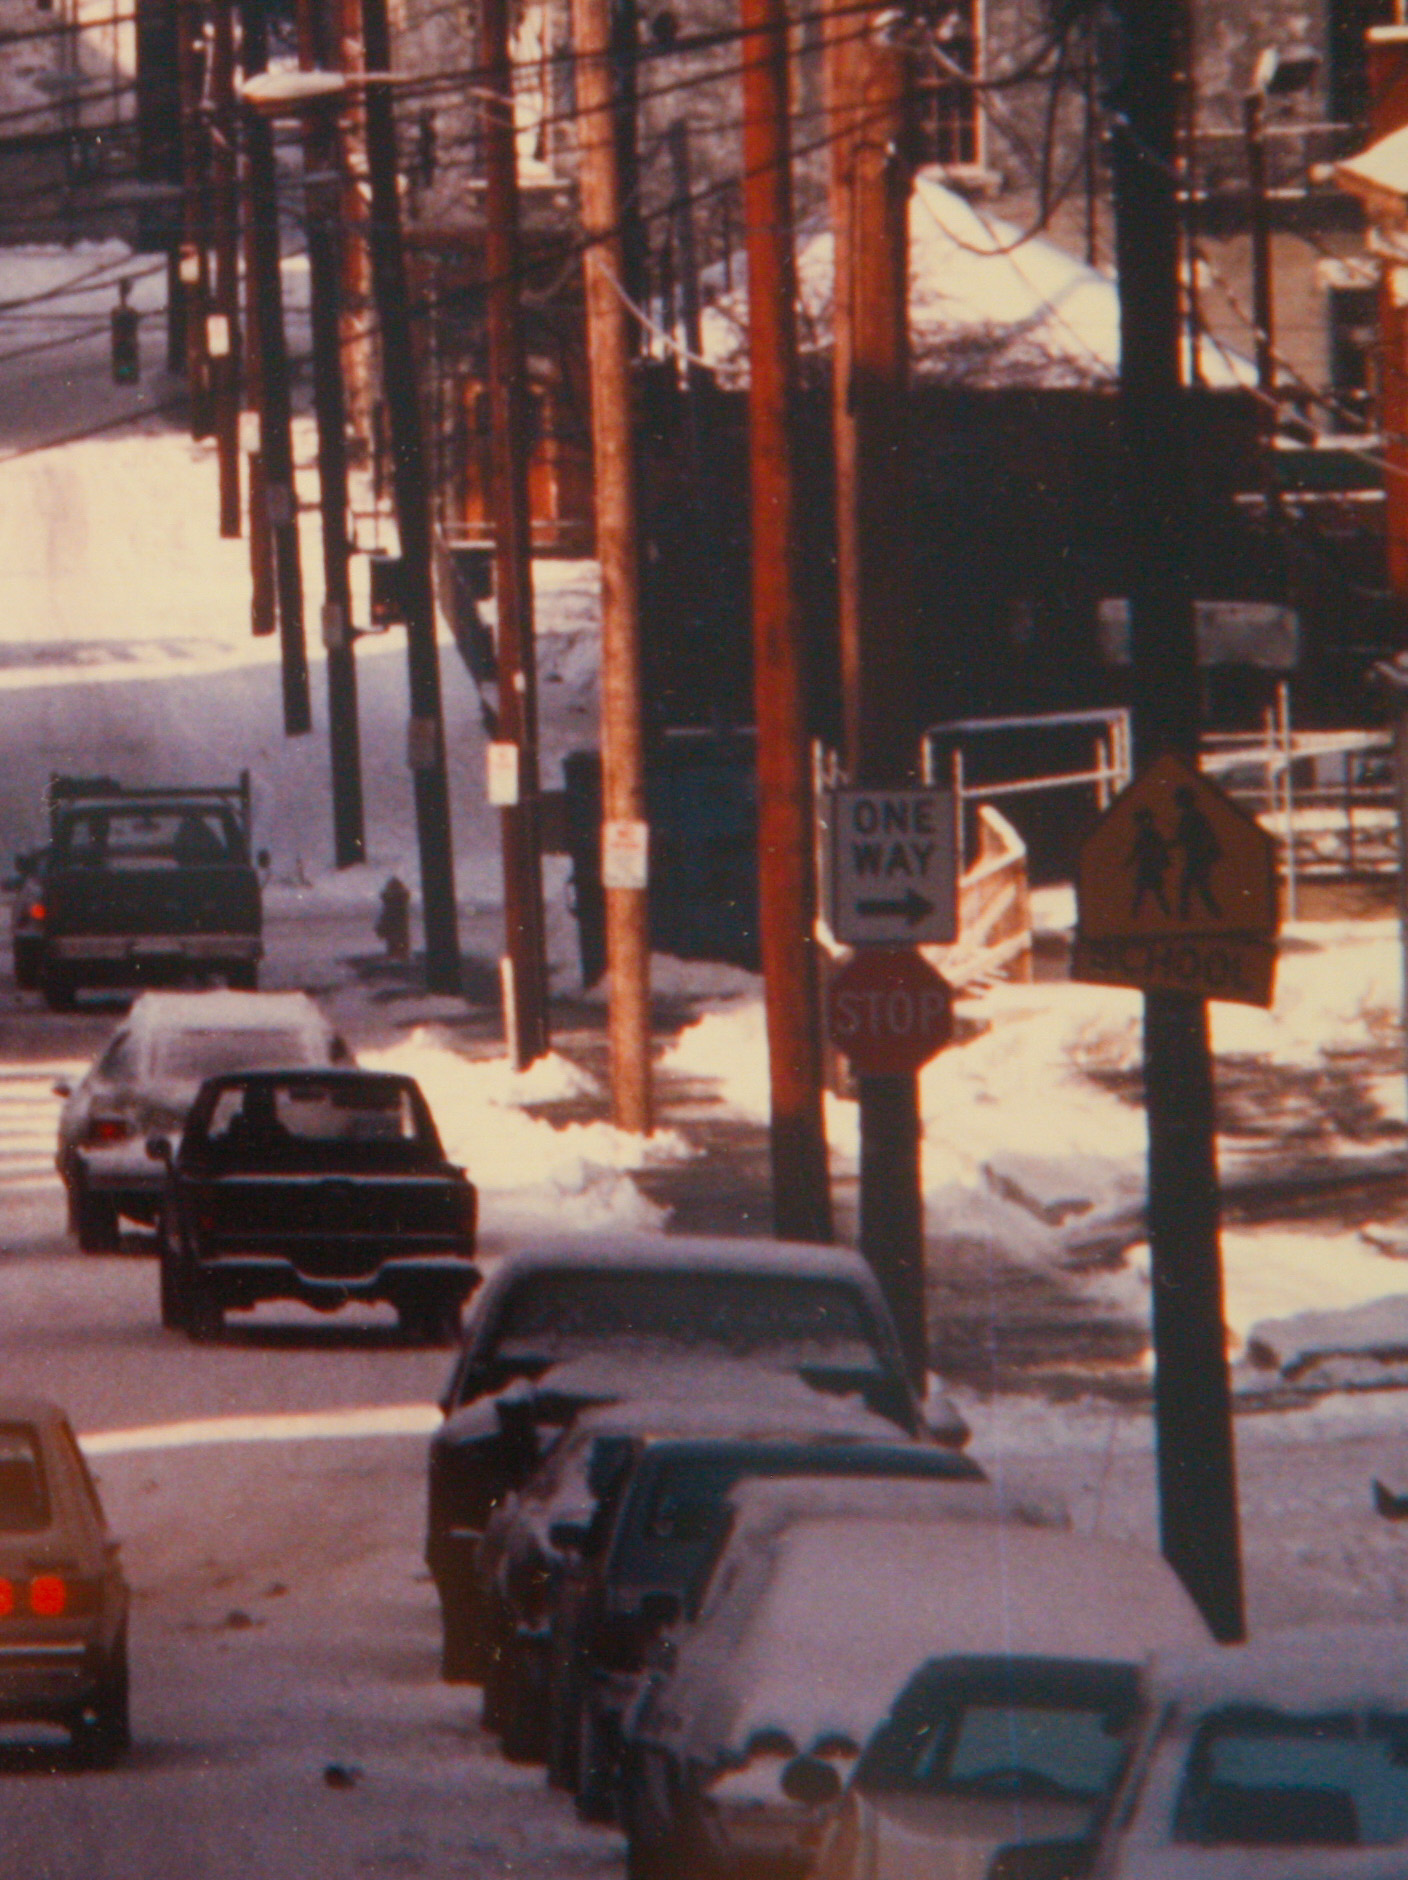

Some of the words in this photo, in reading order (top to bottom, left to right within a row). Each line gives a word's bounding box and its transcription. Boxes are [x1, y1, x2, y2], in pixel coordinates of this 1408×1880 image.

[852, 798, 935, 834] ONE
[851, 841, 934, 877] WAY
[1088, 943, 1251, 992] SCHOOL
[835, 988, 945, 1036] STOP
